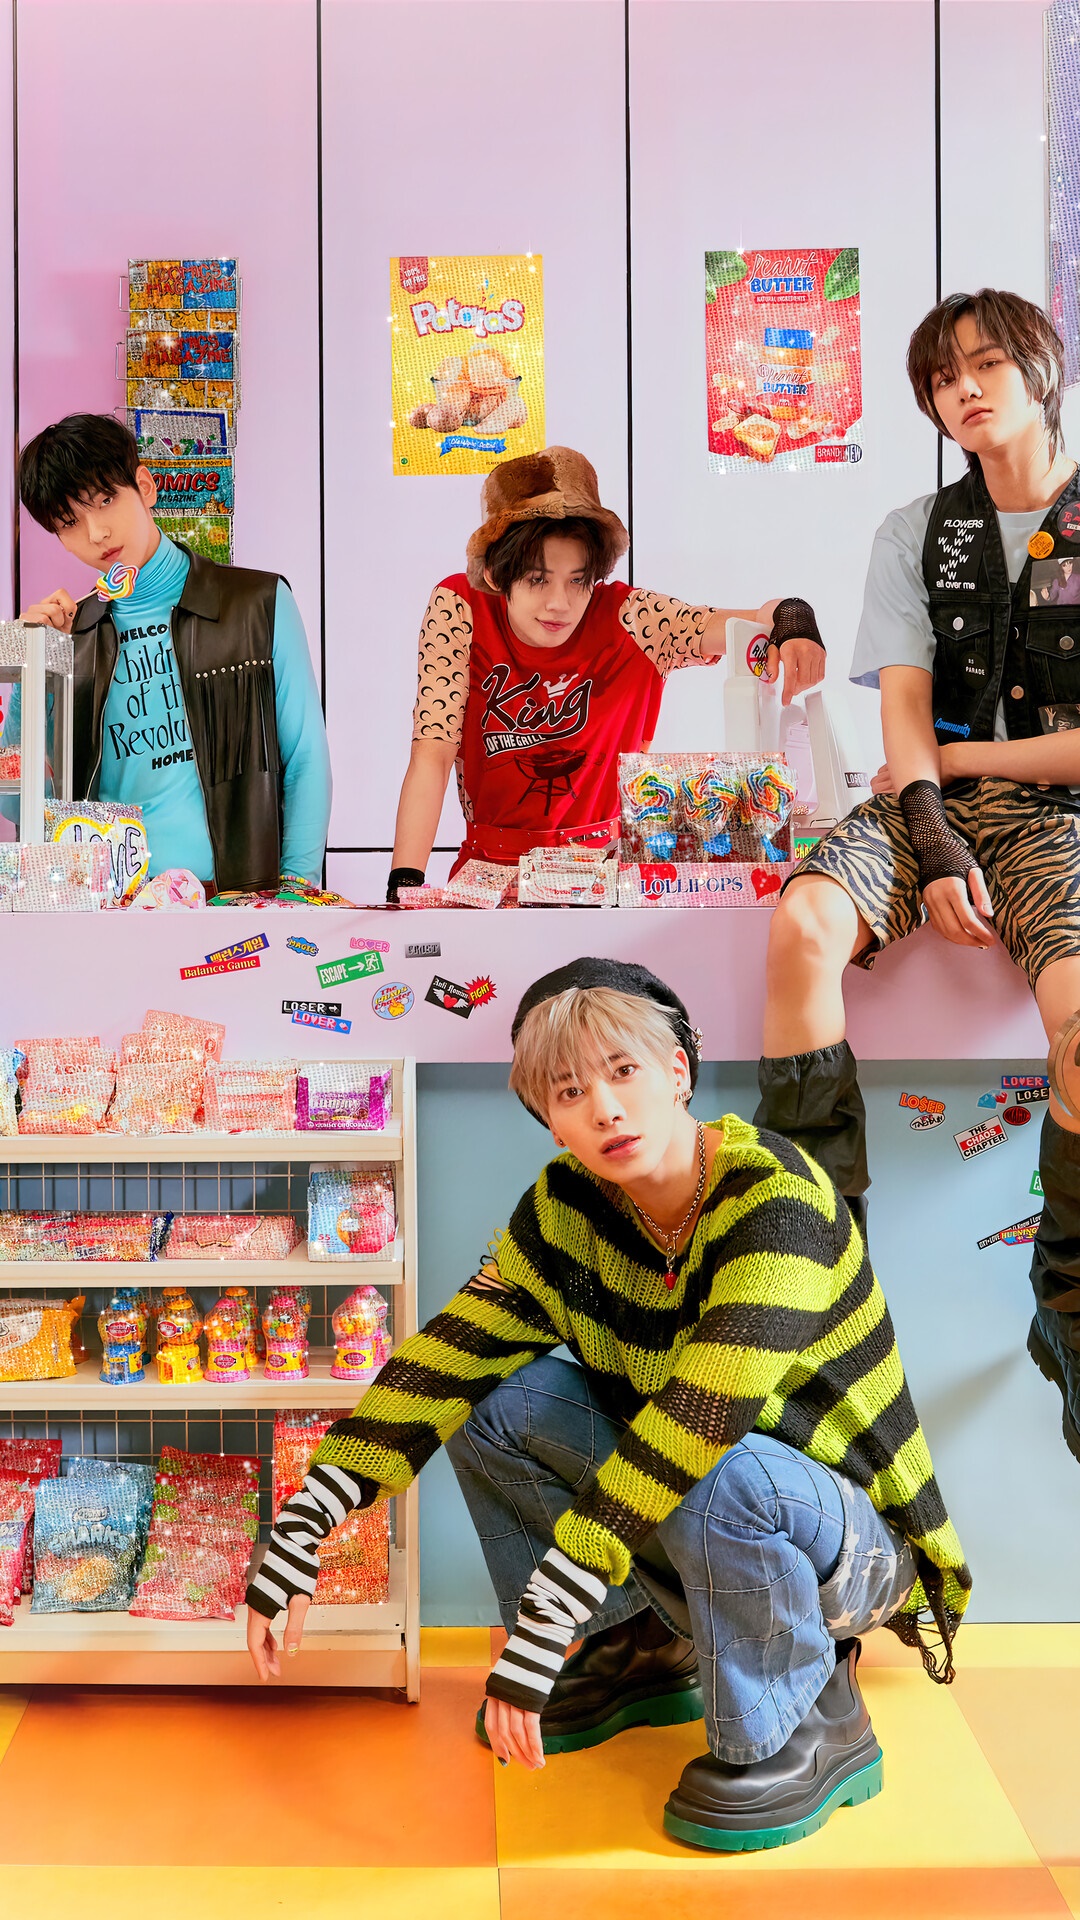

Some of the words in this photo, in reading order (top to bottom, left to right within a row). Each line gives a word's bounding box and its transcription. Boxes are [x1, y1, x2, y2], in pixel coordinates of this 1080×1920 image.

[158, 262, 222, 282] COMICS
[747, 252, 818, 283] Peanut
[147, 277, 235, 295] MAGAZINE
[750, 277, 814, 293] BUTTER
[156, 334, 219, 352] CMICS
[763, 382, 807, 395] BUTTER
[943, 519, 984, 528] FLOWERS
[957, 528, 967, 537] W
[965, 534, 975, 543] W
[938, 536, 948, 545] W
[954, 538, 964, 547] W
[943, 544, 953, 553] W
[951, 548, 961, 557] W
[949, 559, 958, 568] W
[959, 554, 969, 564] W
[939, 563, 948, 573] W
[947, 571, 957, 580] W
[127, 681, 151, 719] of
[161, 674, 184, 711] th
[481, 664, 593, 733] King
[934, 717, 971, 738] Community
[486, 737, 499, 752] OF
[499, 734, 516, 748] THE
[516, 734, 546, 747] GRILL
[795, 847, 812, 858] CHA
[641, 876, 743, 895] LOLLIPOPS
[289, 940, 316, 953] MAGIC
[184, 964, 224, 977] Balance
[227, 959, 256, 970] Game
[320, 963, 348, 985] ESCAPE
[433, 977, 447, 988] Anti
[380, 985, 397, 996] The
[469, 982, 490, 1001] FIGHT
[969, 1123, 987, 1137] THE
[967, 1128, 997, 1147] CHAOS
[963, 1133, 1006, 1157] CHAPTER
